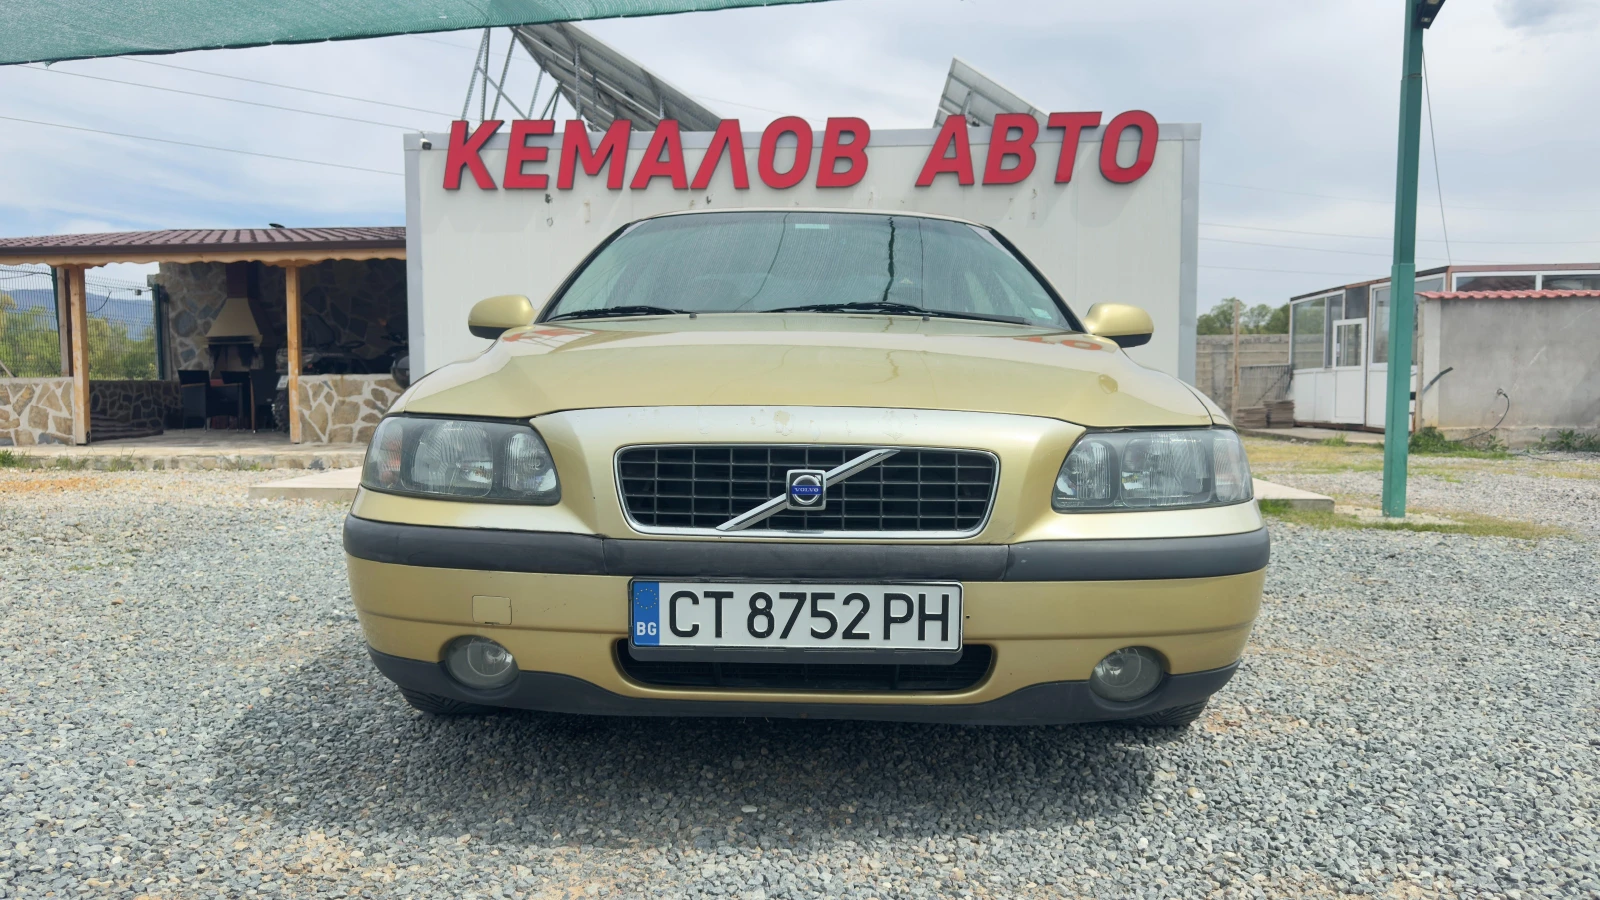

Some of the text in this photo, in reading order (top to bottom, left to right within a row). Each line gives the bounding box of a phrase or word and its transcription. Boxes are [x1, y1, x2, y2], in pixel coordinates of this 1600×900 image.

[443, 110, 1159, 190] КЕМАЛОВ АВТО
[636, 621, 657, 636] BG
[669, 590, 949, 642] CT 8752 PH
